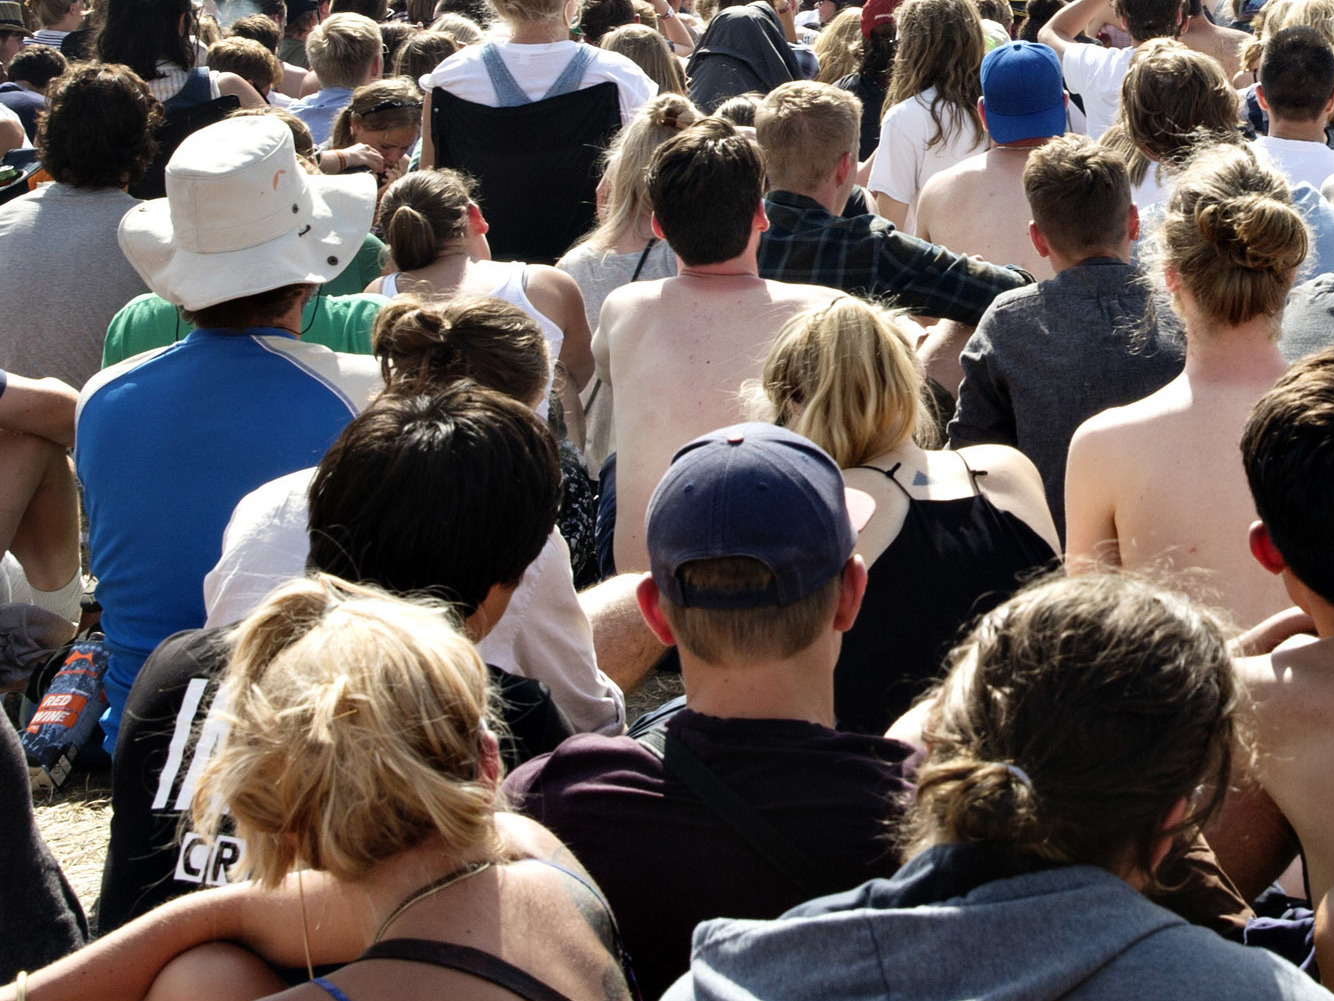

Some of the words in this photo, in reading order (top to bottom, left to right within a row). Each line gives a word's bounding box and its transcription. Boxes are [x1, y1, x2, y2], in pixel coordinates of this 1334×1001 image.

[42, 694, 73, 707] RED
[31, 710, 70, 723] WINE
[180, 835, 243, 883] CR
